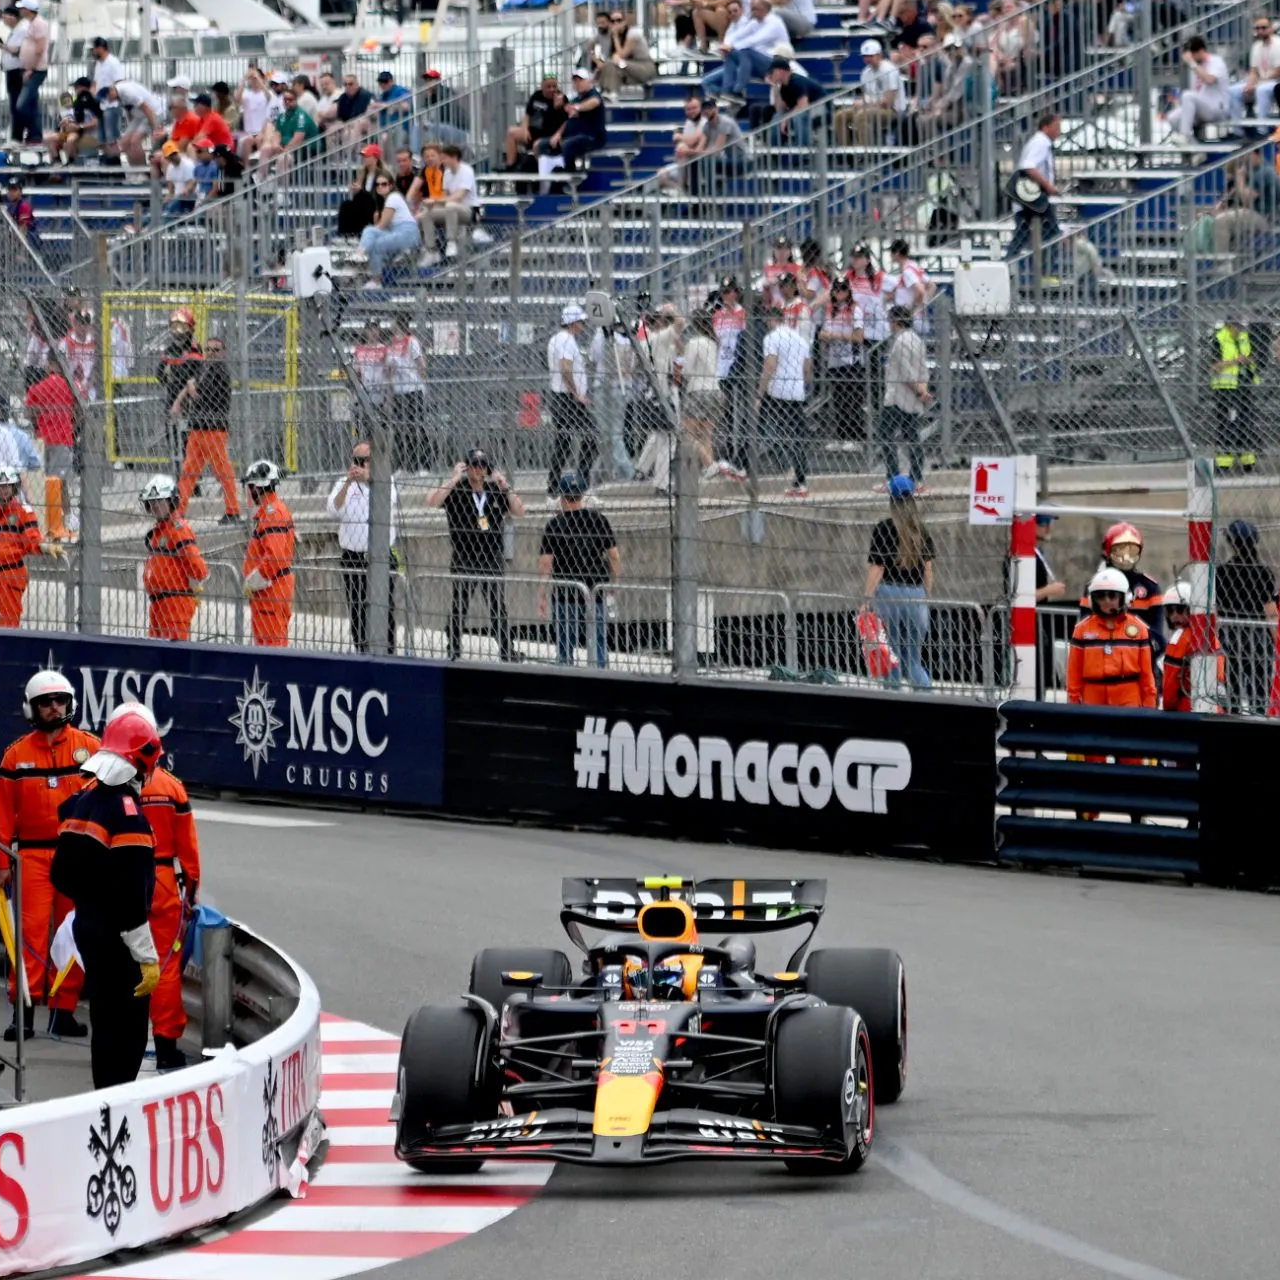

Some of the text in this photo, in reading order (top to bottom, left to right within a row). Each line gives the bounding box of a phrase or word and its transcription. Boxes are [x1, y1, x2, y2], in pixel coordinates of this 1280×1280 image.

[974, 495, 1006, 504] FIRE
[286, 683, 389, 758] MSC
[286, 765, 389, 793] CRUISES
[574, 716, 912, 814] #MonacoGP
[143, 1082, 227, 1213] UBS
